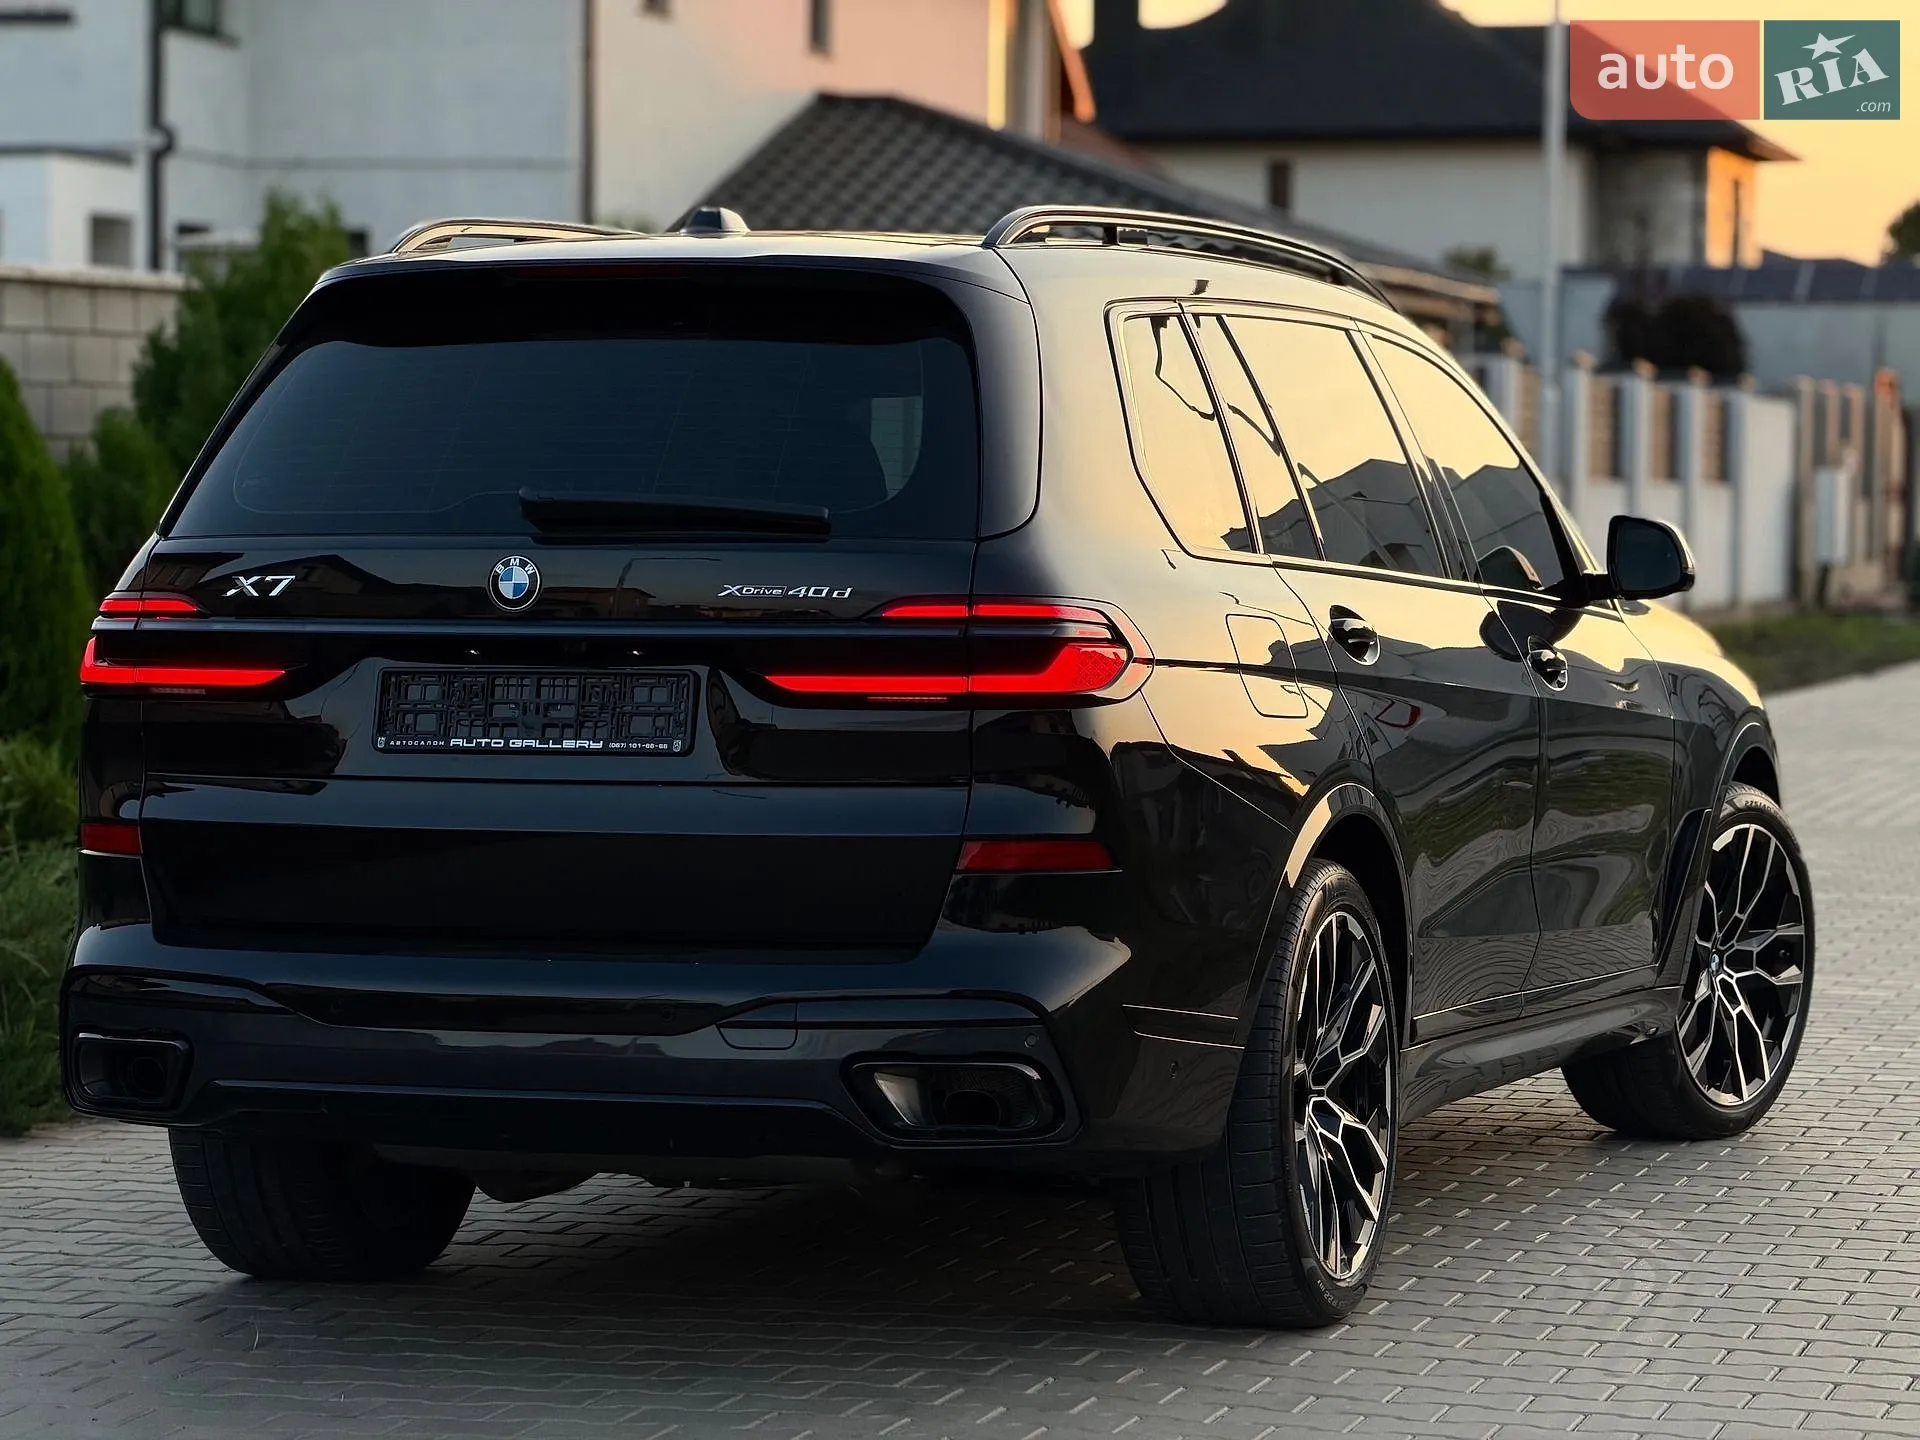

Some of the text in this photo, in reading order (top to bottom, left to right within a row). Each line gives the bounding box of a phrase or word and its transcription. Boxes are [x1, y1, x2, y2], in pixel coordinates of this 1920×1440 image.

[495, 558, 536, 575] BMW
[221, 575, 296, 597] X7
[450, 738, 504, 747] AUTO
[509, 739, 603, 748] GALLERY
